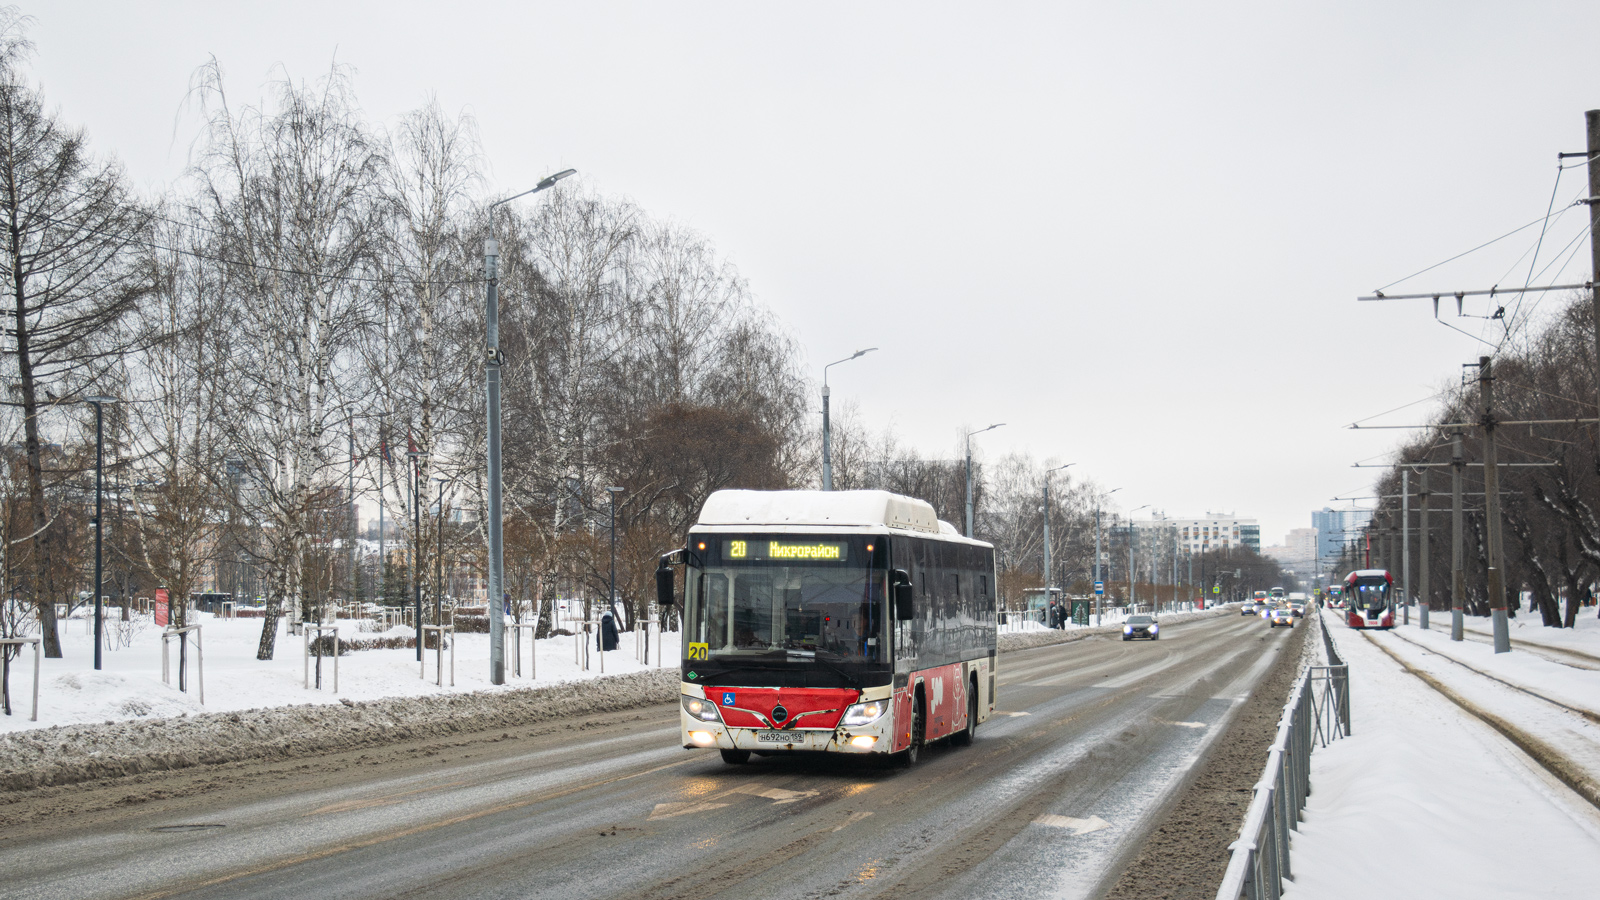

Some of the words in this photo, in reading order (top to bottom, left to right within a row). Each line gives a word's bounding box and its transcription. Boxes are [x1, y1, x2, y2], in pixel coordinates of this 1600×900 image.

[731, 541, 746, 557] 20
[769, 541, 840, 558] Микрорайон
[690, 646, 707, 660] 20
